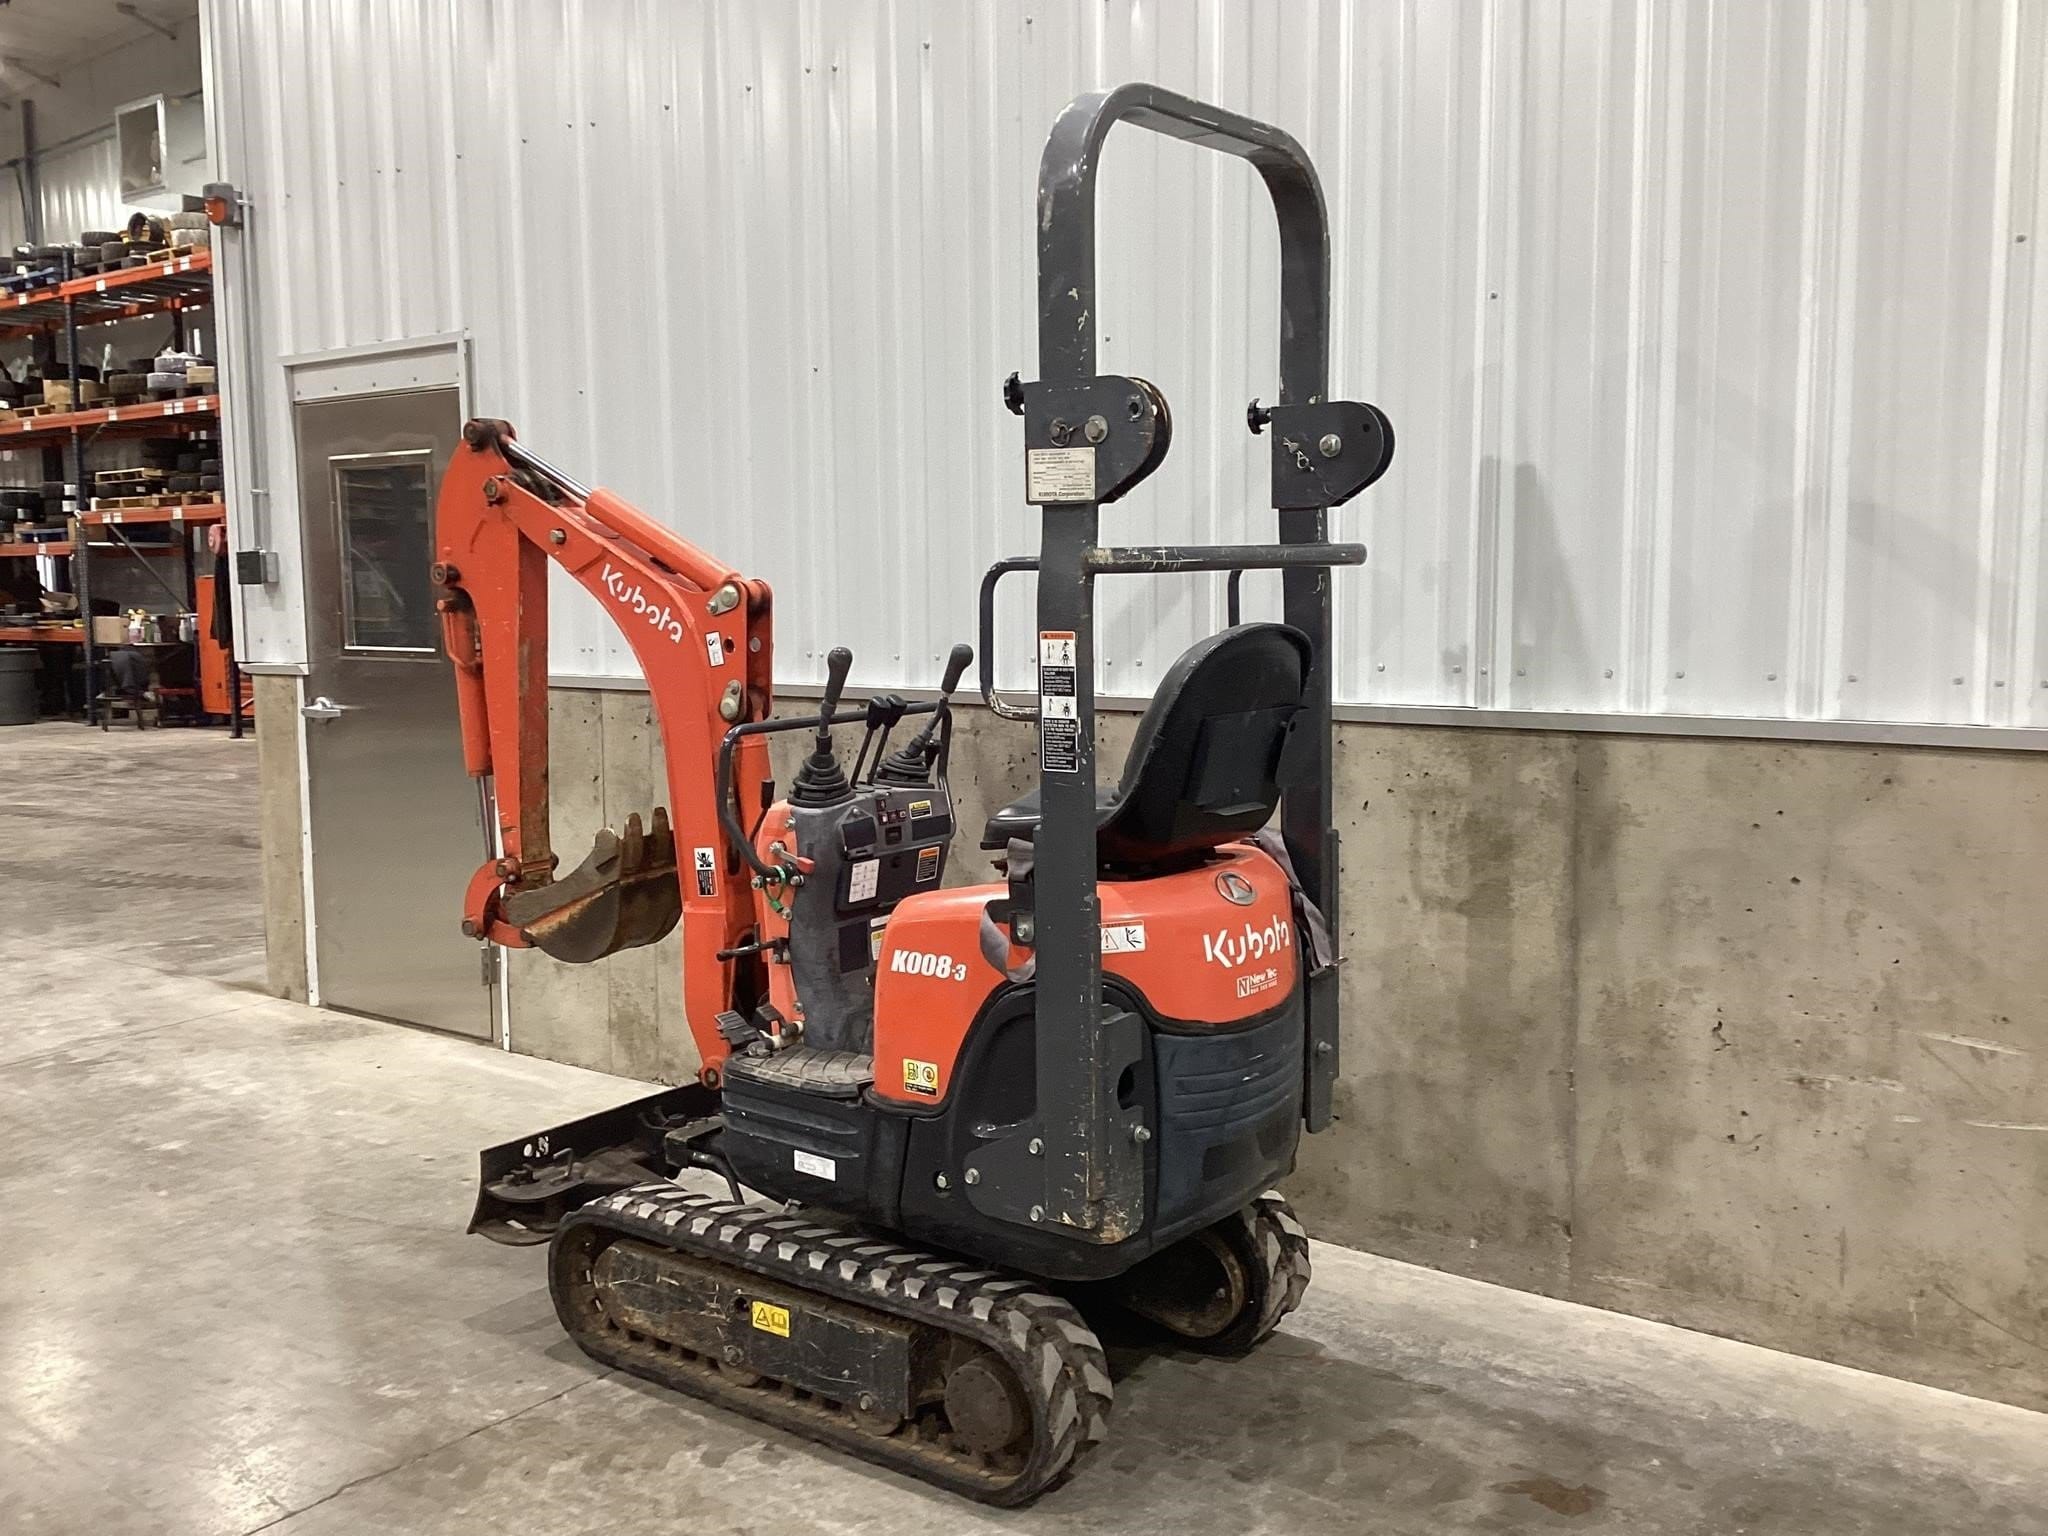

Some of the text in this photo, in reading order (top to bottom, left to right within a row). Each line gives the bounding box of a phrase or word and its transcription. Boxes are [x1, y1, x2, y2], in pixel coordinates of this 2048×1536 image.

[602, 563, 683, 643] Kubota
[890, 949, 967, 981] K008-3
[1202, 914, 1290, 968] Kubota
